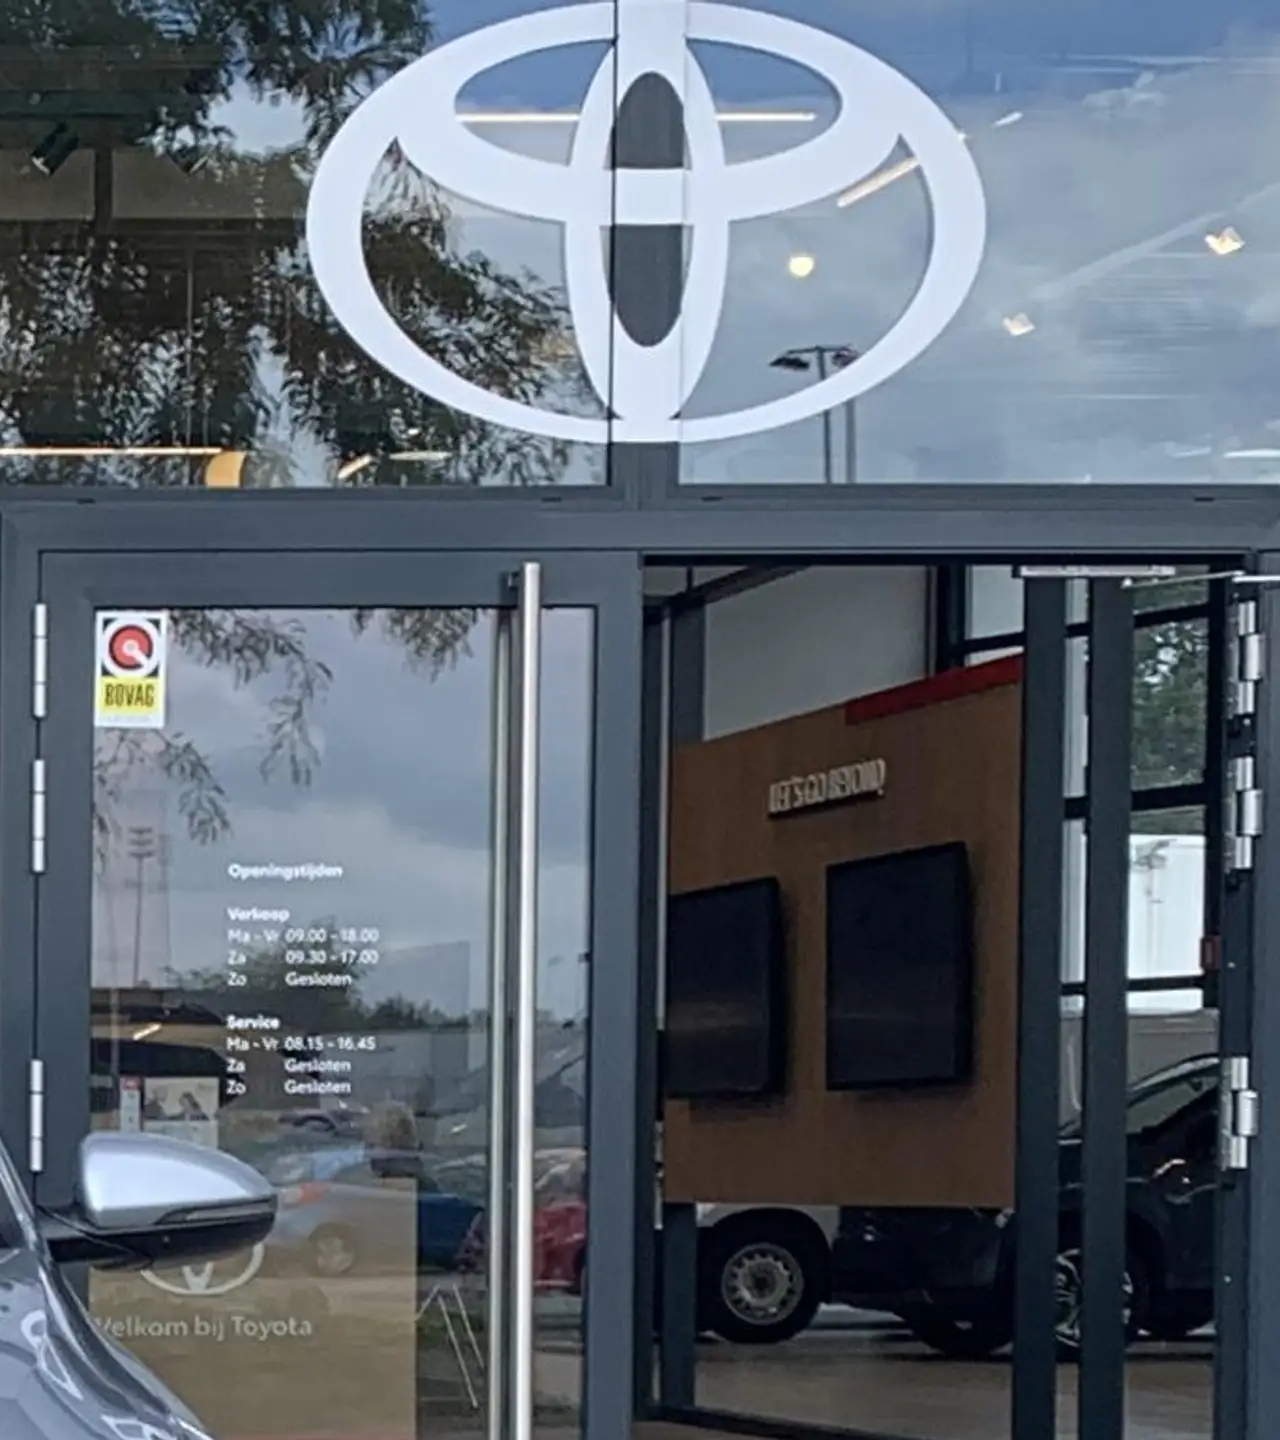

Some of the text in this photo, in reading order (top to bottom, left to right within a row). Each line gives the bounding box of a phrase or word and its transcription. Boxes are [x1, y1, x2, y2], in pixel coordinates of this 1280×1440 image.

[104, 683, 155, 708] BOVAG
[228, 863, 343, 881] Openingstijden
[227, 907, 290, 923] Verkoop
[228, 929, 251, 943] Ma
[263, 929, 279, 943] Vr
[285, 928, 327, 943] 09.00
[341, 928, 380, 943] 18.00
[227, 950, 247, 965] Za
[285, 949, 327, 964] 09.30
[341, 949, 380, 965] 17.00
[227, 971, 352, 987] Zo Gesloten
[226, 1014, 281, 1030] Service
[226, 1038, 250, 1051] Ma
[262, 1037, 279, 1051] Vr
[284, 1036, 325, 1051] 08.15
[338, 1036, 376, 1051] 16.45
[226, 1058, 352, 1073] Za Gesloten
[226, 1080, 352, 1095] Zo Gesloten
[194, 1316, 225, 1342] bij
[230, 1316, 313, 1342] Toyota
